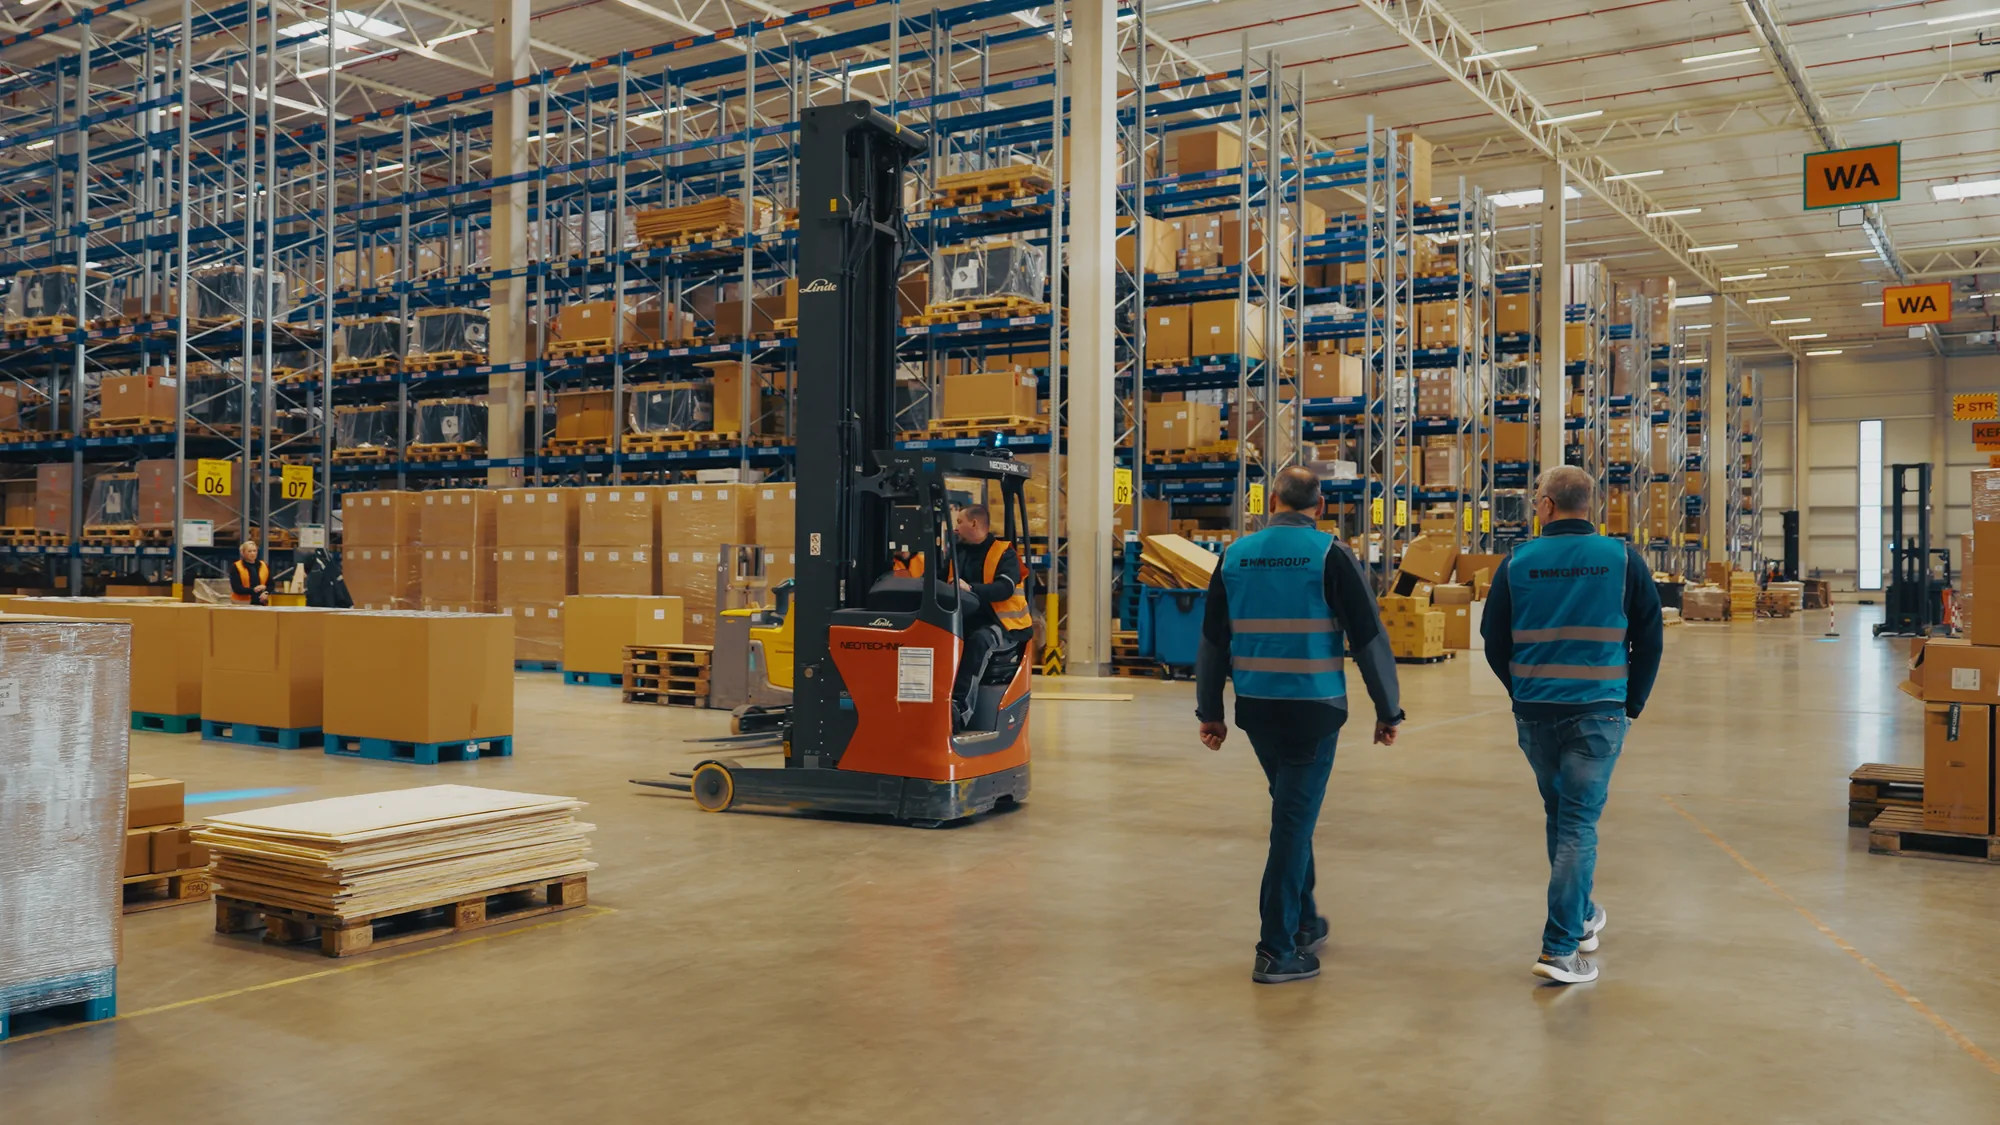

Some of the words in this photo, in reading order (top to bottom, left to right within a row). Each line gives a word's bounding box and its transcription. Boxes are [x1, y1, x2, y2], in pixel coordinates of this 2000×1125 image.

[1823, 162, 1880, 191] WA
[799, 278, 837, 293] Linde
[1897, 295, 1937, 314] WA
[1957, 403, 1965, 412] P
[1968, 402, 1994, 412] STR
[204, 476, 224, 494] 06
[288, 481, 307, 498] 07
[1117, 485, 1128, 503] 09
[1253, 498, 1261, 513] 10
[868, 617, 893, 627] Linde
